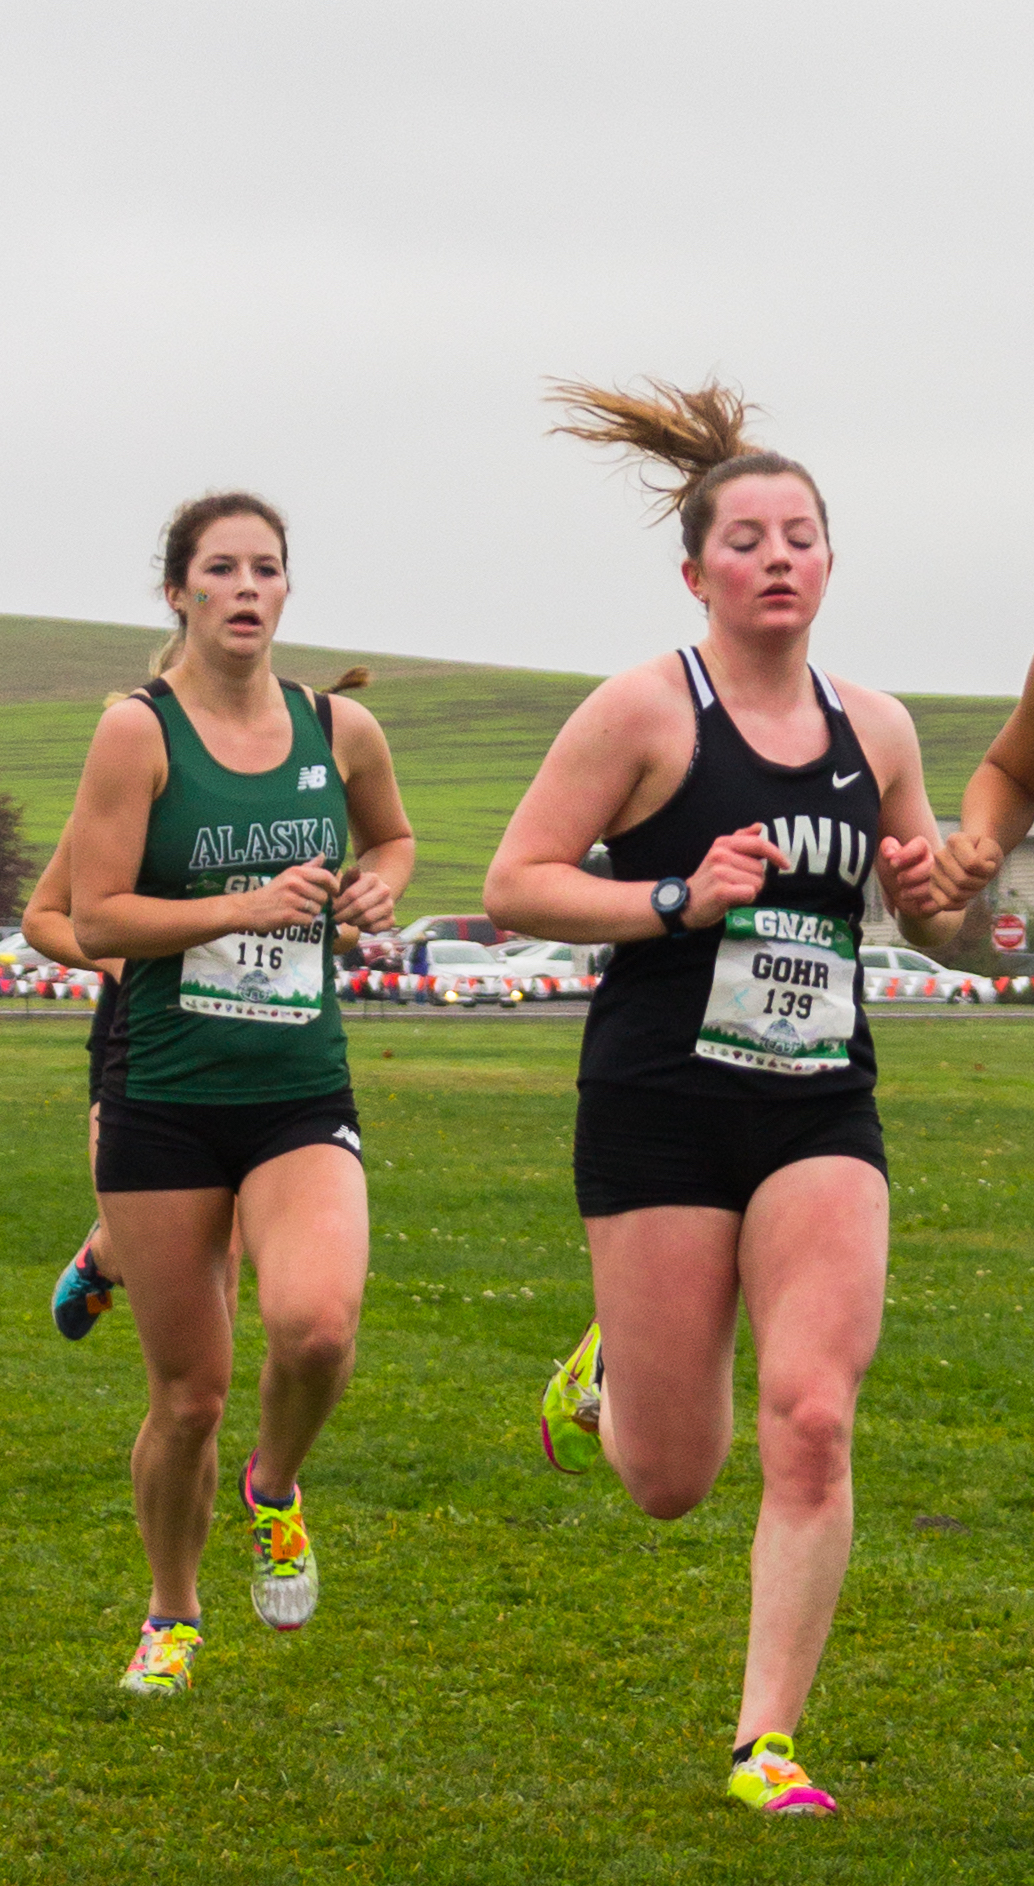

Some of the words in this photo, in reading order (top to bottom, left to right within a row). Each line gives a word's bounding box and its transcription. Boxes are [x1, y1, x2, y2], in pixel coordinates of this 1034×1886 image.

[188, 817, 339, 870] ALASKA
[224, 874, 272, 895] GN
[753, 909, 834, 947] GNAC
[236, 942, 284, 970] 116
[751, 952, 829, 989] GOHR
[762, 988, 813, 1020] 139
